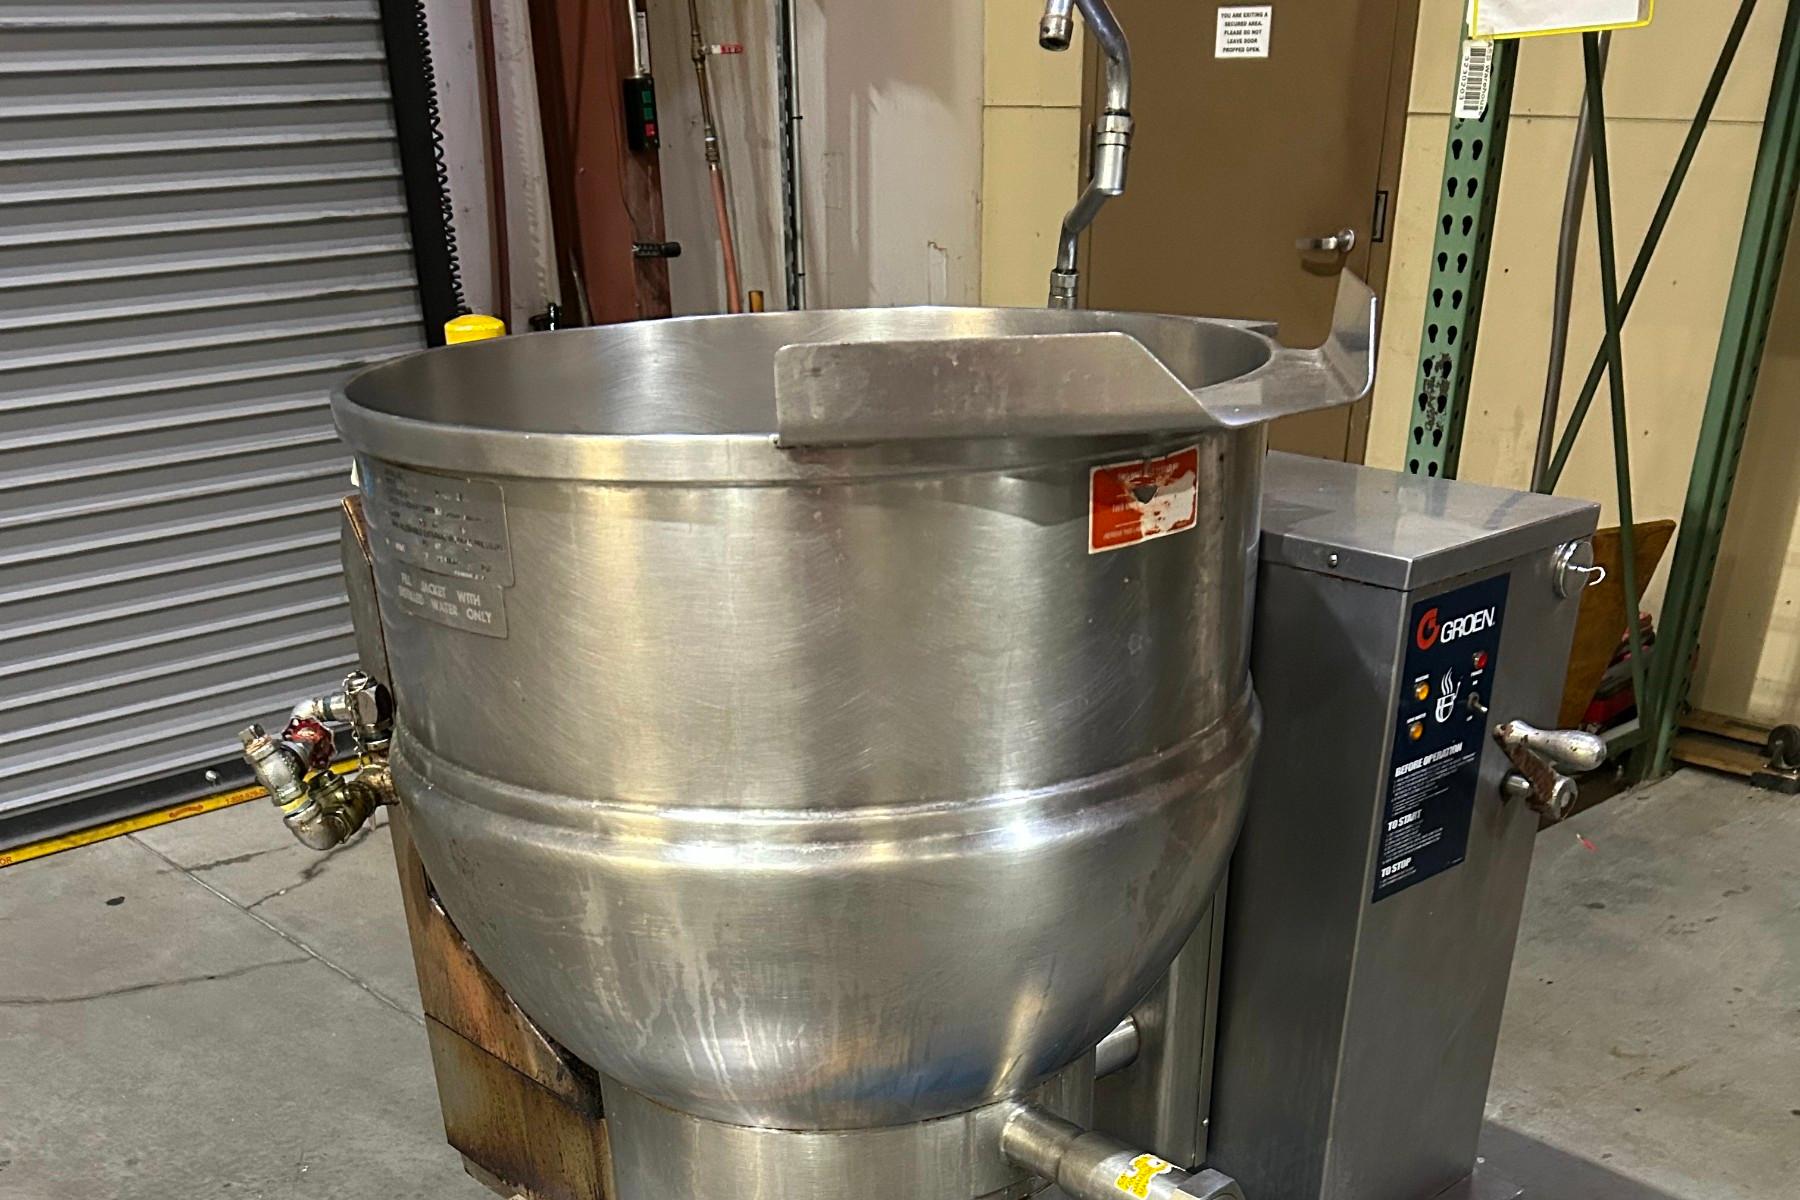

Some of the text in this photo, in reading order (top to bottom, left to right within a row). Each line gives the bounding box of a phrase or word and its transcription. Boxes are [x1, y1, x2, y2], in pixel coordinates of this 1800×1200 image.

[456, 590, 480, 606] WITH
[431, 598, 458, 617] WATER
[466, 607, 492, 624] ONLY
[1440, 606, 1495, 643] GROEN
[1395, 742, 1463, 777] BEFORE OPERATION
[1388, 809, 1422, 831] TO START
[1381, 857, 1412, 878] TO STOP
